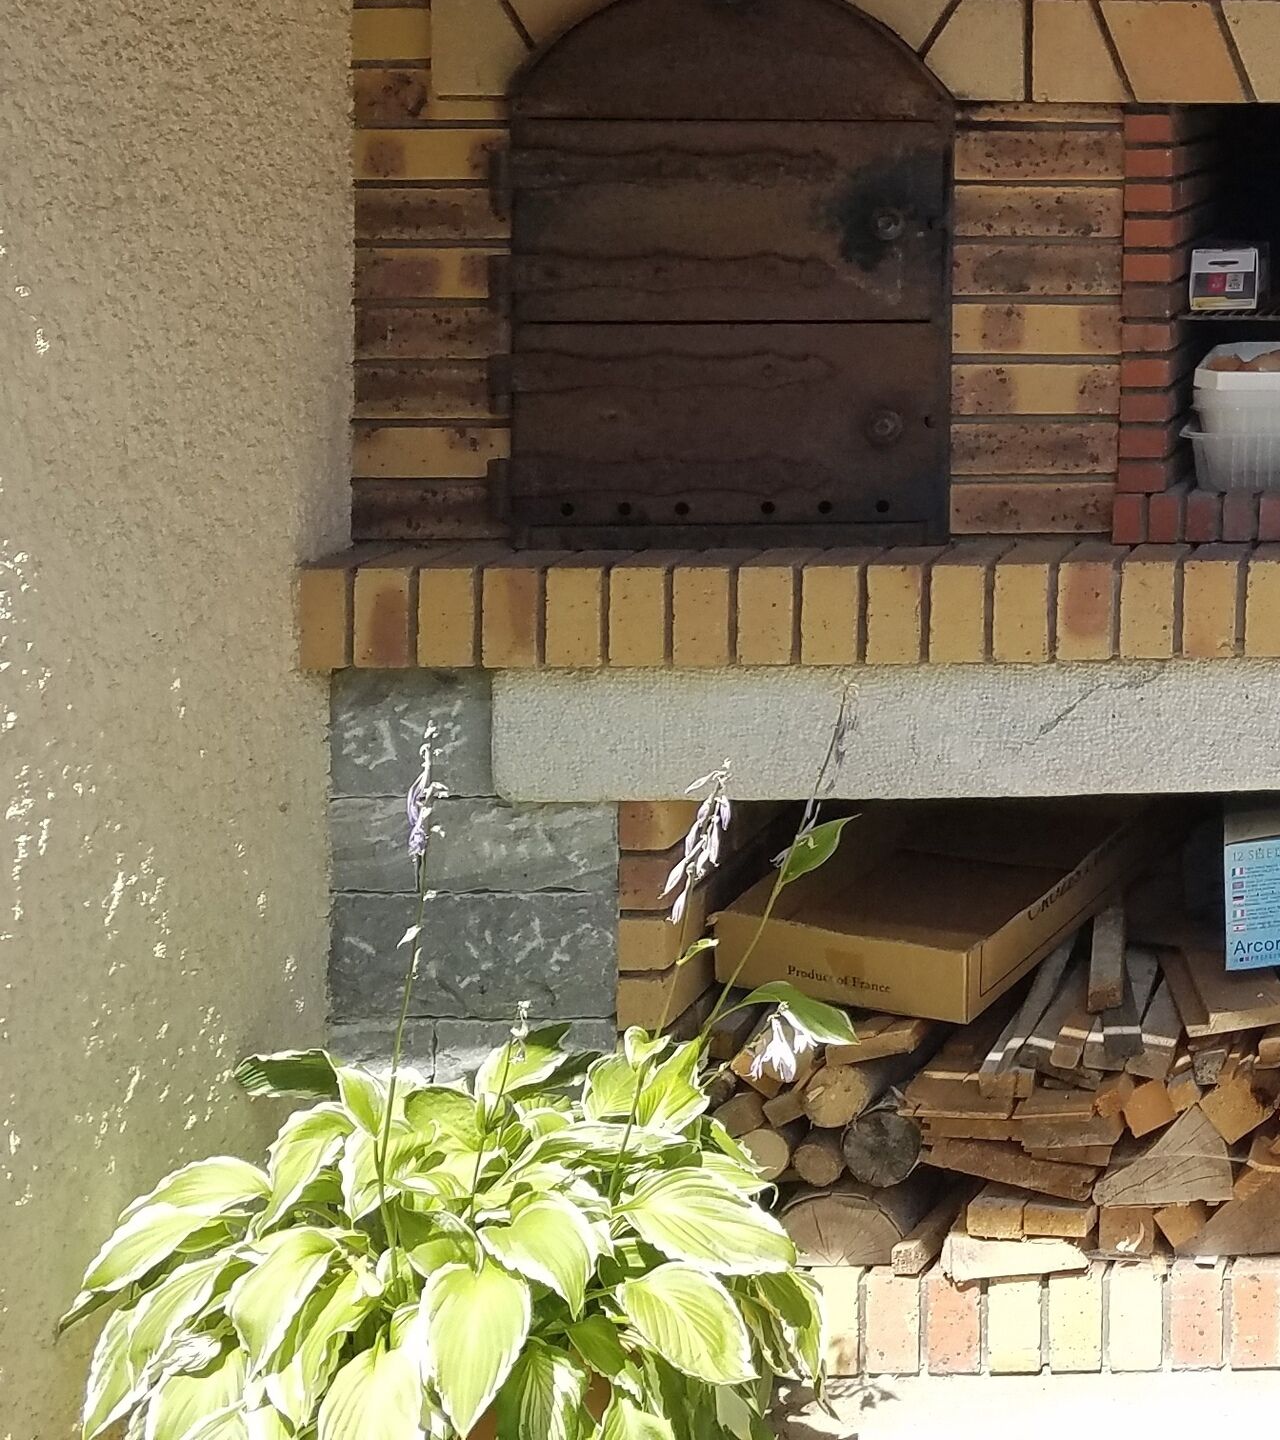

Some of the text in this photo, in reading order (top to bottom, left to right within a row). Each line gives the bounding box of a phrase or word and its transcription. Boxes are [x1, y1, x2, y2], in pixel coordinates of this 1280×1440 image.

[1233, 850, 1244, 862] 12
[837, 975, 850, 985] of
[852, 976, 891, 993] France
